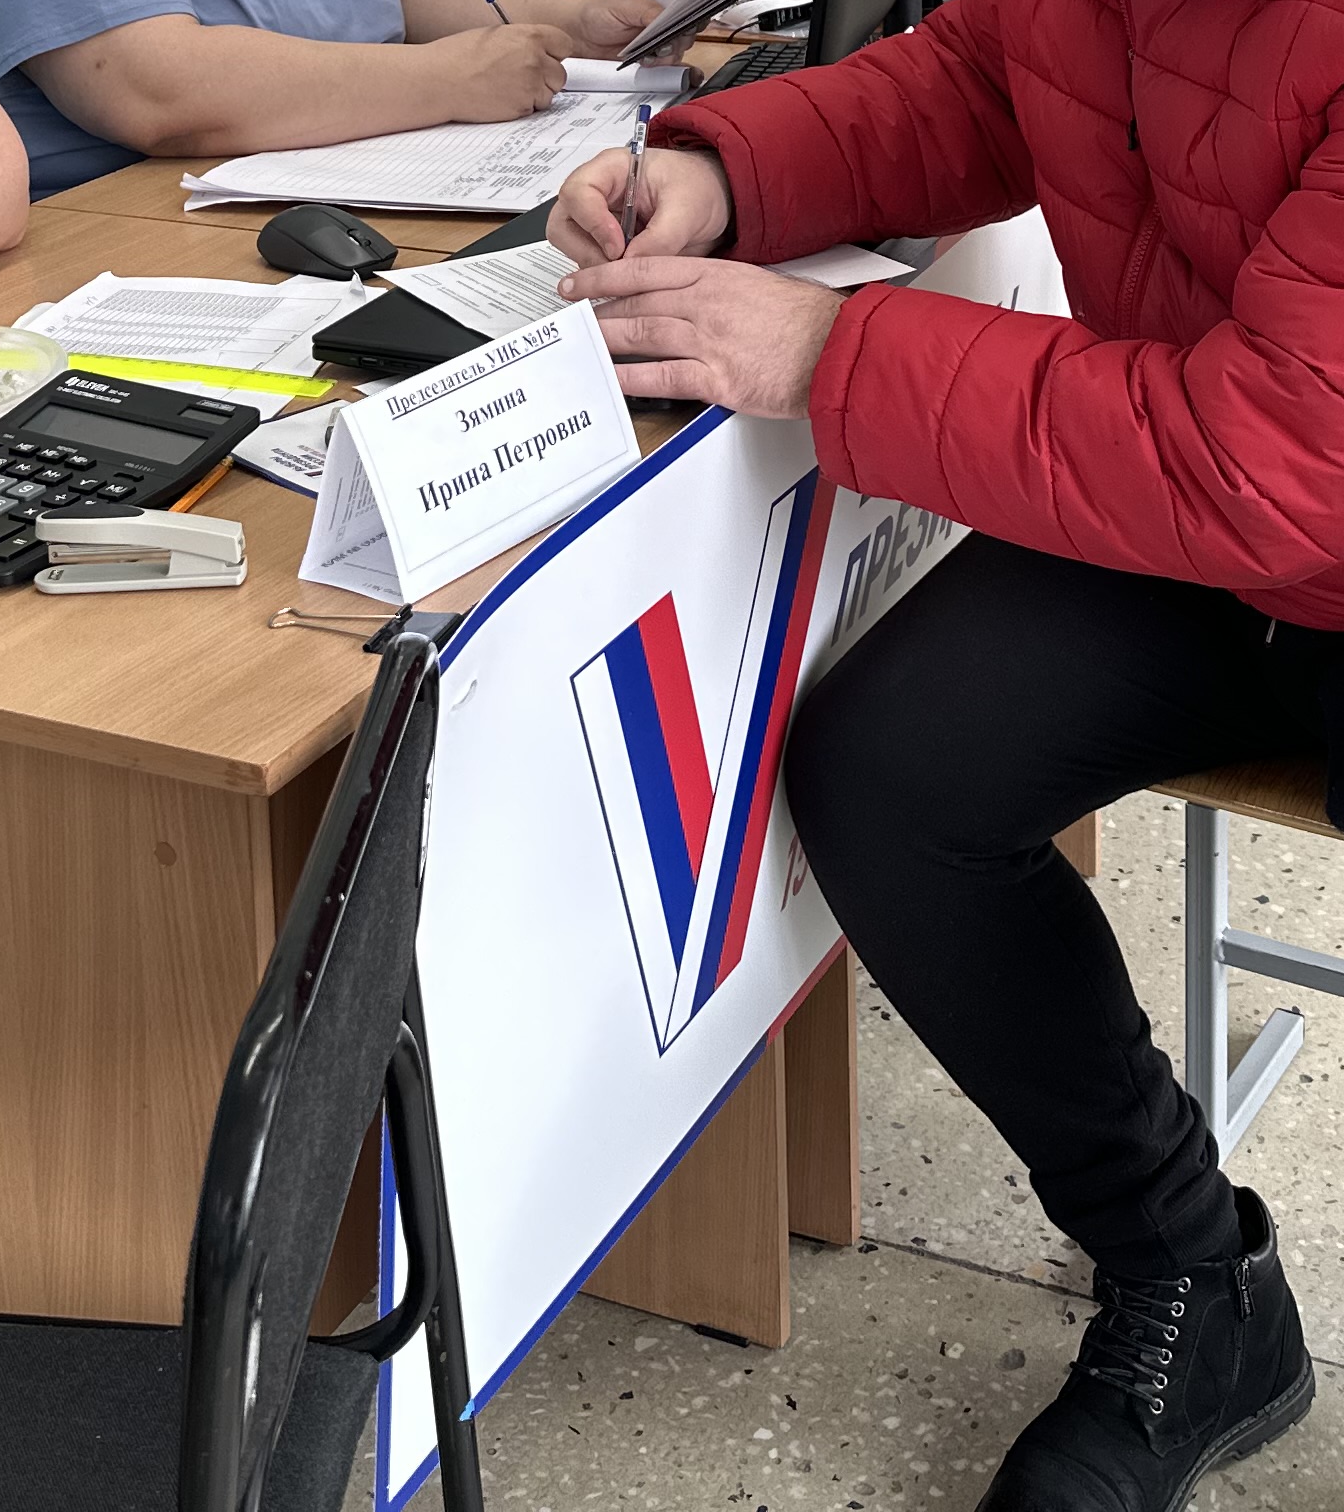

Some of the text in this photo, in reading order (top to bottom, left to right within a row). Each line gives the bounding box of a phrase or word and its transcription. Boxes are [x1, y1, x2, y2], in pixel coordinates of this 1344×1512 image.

[386, 321, 561, 417] Председатель УИК №195
[455, 388, 528, 433] Зямина
[18, 484, 34, 495] 9
[416, 410, 593, 514] Ирина Петровна
